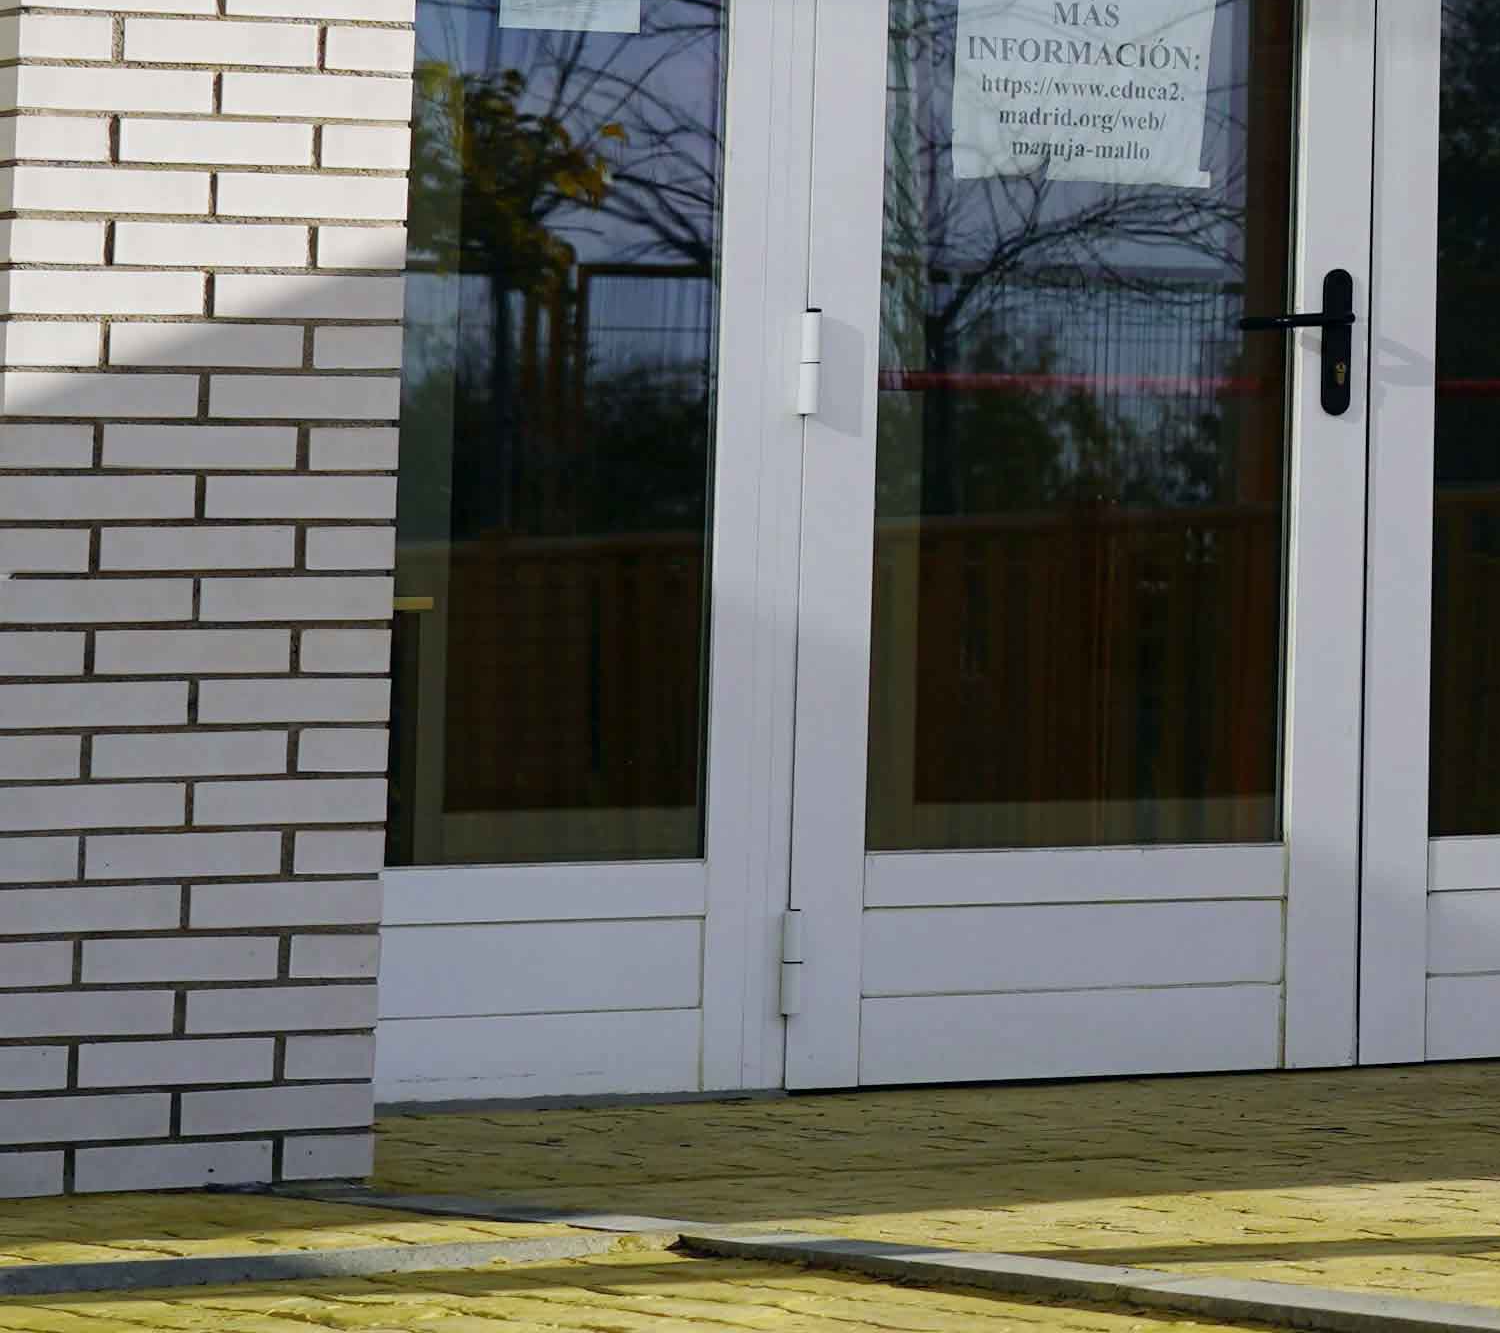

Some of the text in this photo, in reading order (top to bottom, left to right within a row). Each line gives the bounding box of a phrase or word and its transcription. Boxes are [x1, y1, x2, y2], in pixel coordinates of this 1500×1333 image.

[967, 35, 1201, 72] INFORMACIÓN:
[981, 73, 1186, 101] https://www.educa2.
[999, 107, 1167, 134] madrid.org/web/
